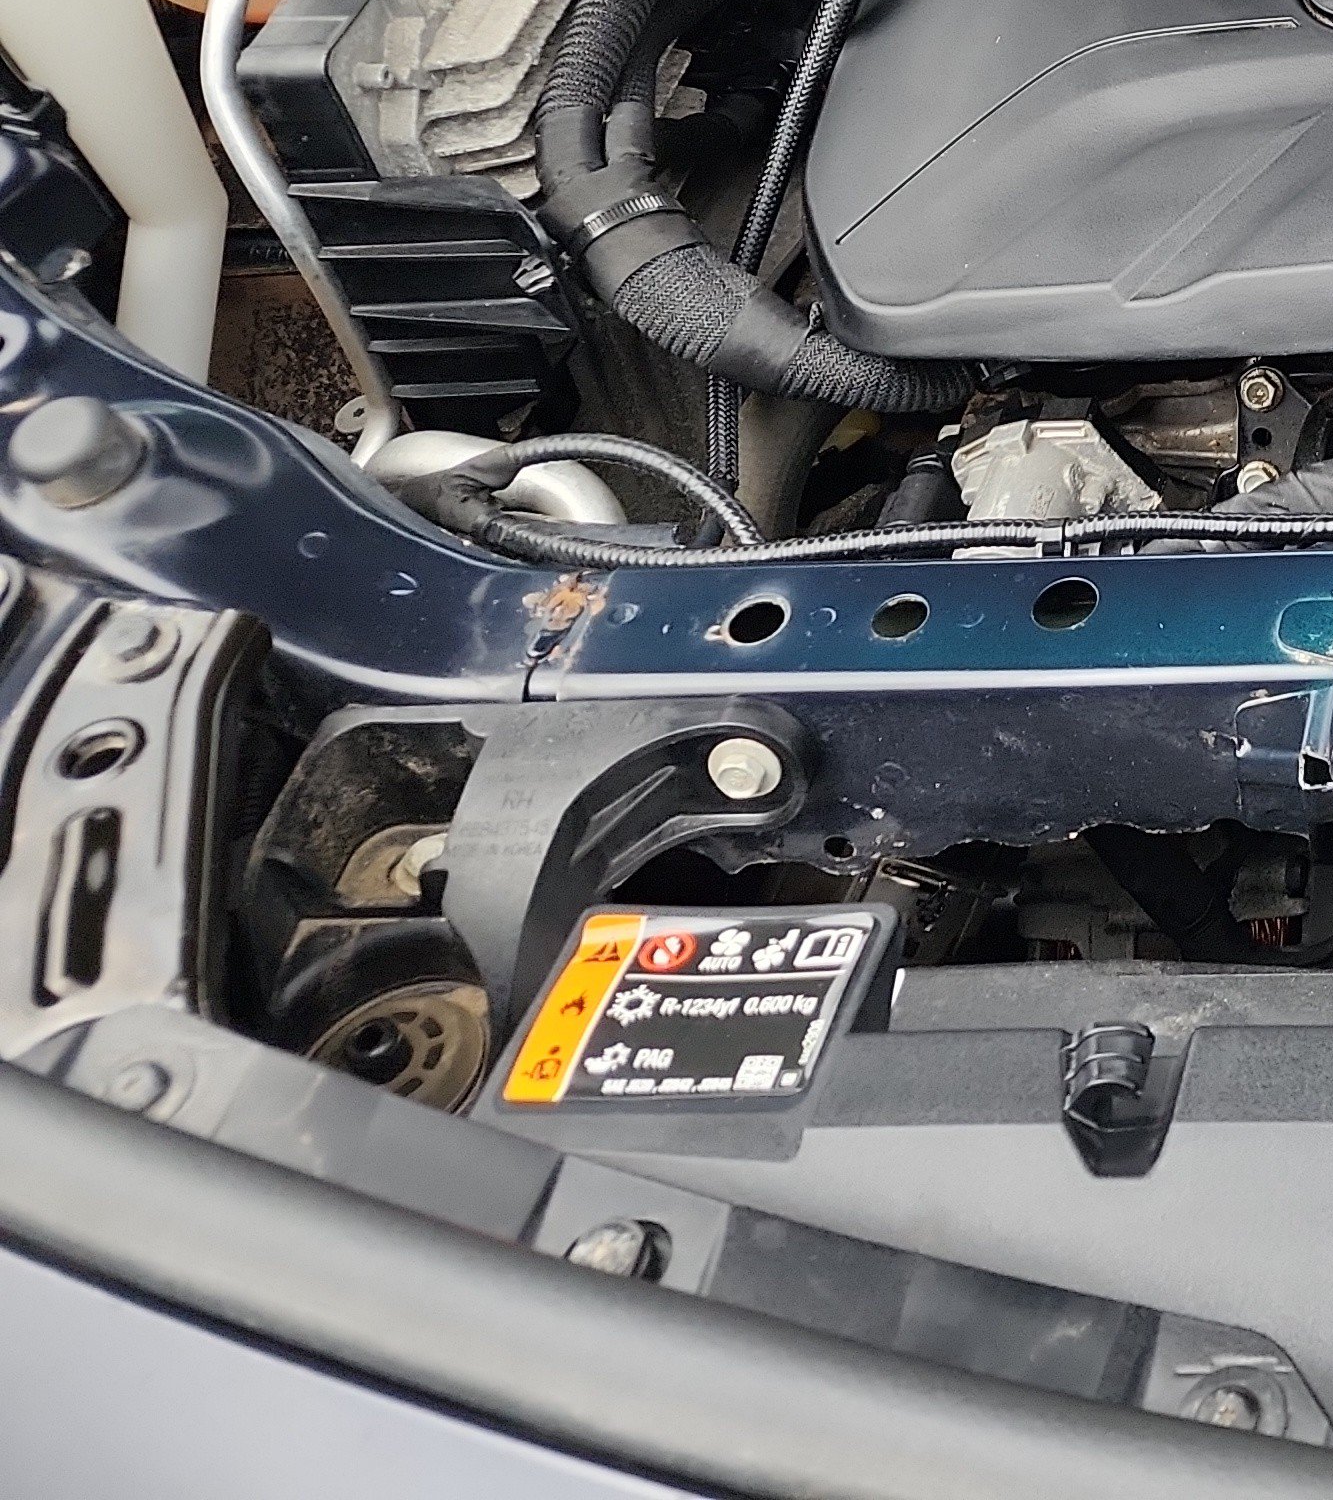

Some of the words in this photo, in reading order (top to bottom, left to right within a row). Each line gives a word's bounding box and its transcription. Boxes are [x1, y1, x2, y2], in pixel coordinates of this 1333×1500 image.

[698, 956, 743, 972] AUTO
[743, 995, 792, 1018] 0.600
[792, 994, 819, 1016] kg
[632, 1048, 675, 1069] PAG
